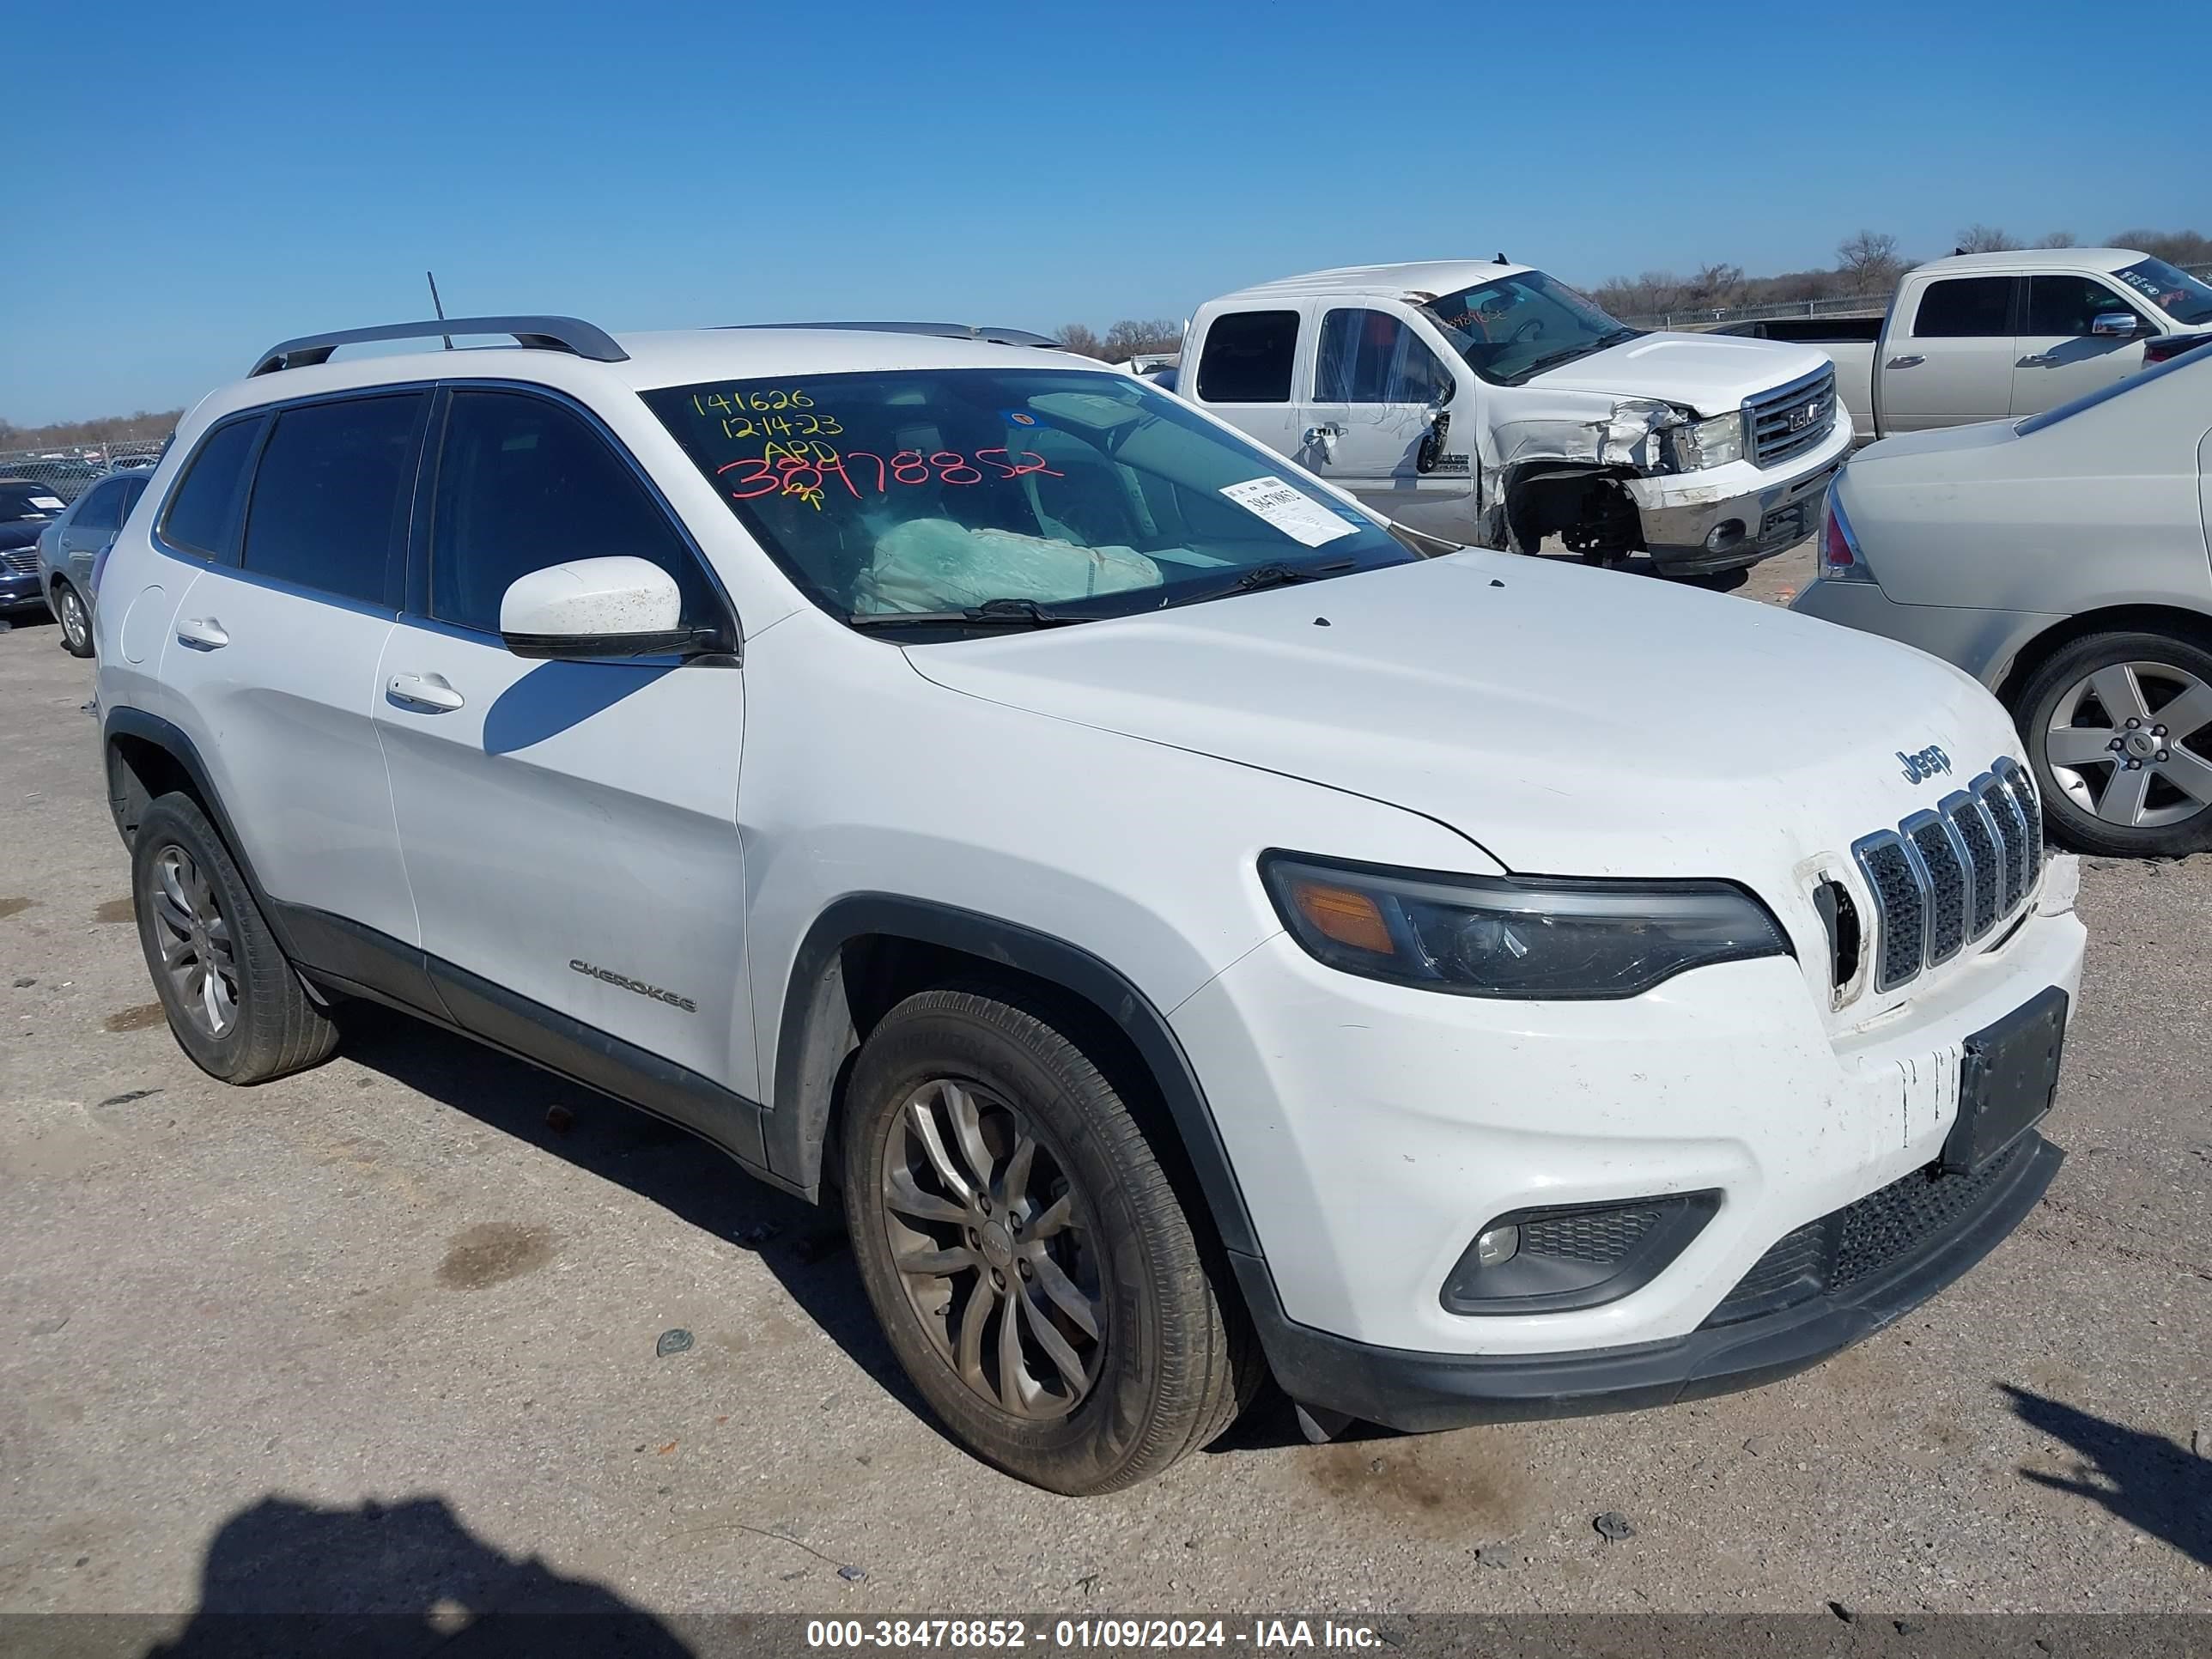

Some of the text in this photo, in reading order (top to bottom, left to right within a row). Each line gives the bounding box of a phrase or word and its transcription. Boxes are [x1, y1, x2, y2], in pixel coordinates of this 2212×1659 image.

[693, 390, 814, 416] 141626
[721, 414, 844, 439] 12-14-23
[764, 440, 837, 465] APD
[717, 448, 1065, 500] 38478852
[1247, 489, 1301, 512] 38478852
[1894, 744, 1953, 785] Jeep
[568, 959, 698, 1013] CHEROKEE
